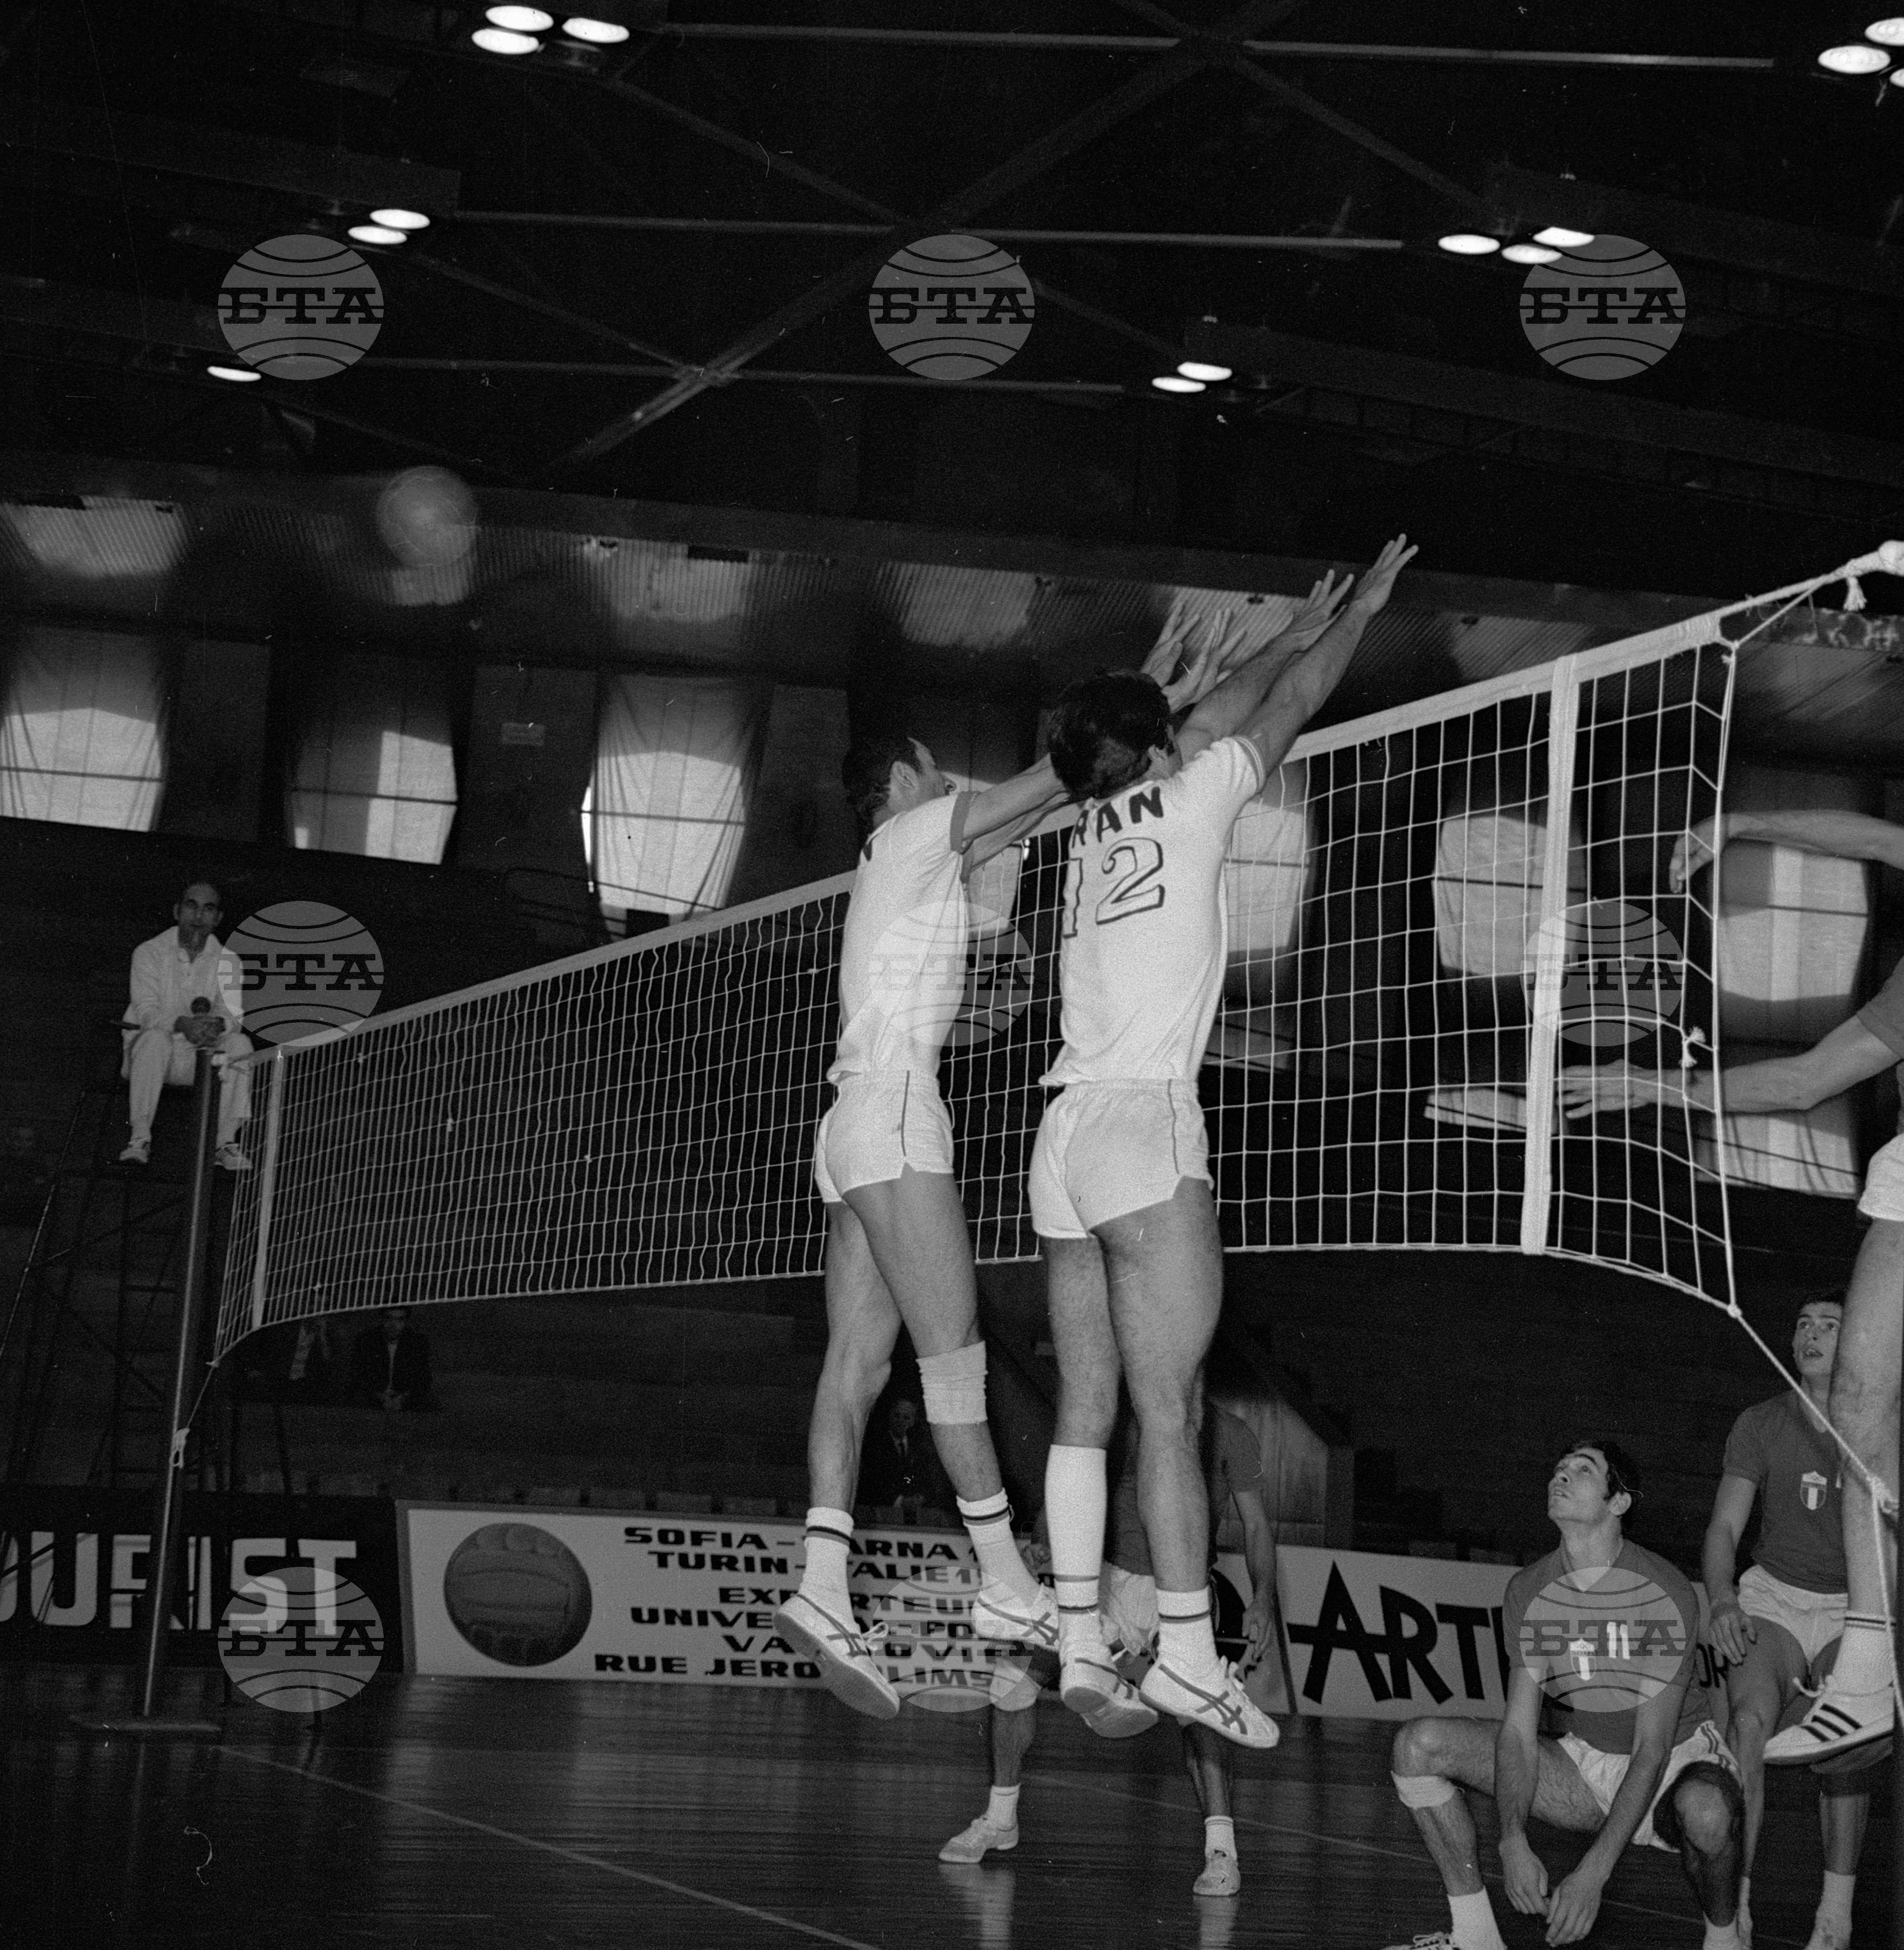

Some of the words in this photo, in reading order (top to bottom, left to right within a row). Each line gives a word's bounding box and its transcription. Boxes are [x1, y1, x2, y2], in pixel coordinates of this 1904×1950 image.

[1072, 786, 1164, 848] RAN
[0, 1530, 357, 1636] URIST
[595, 1654, 687, 1674] RUE
[1606, 1621, 1630, 1660] 11
